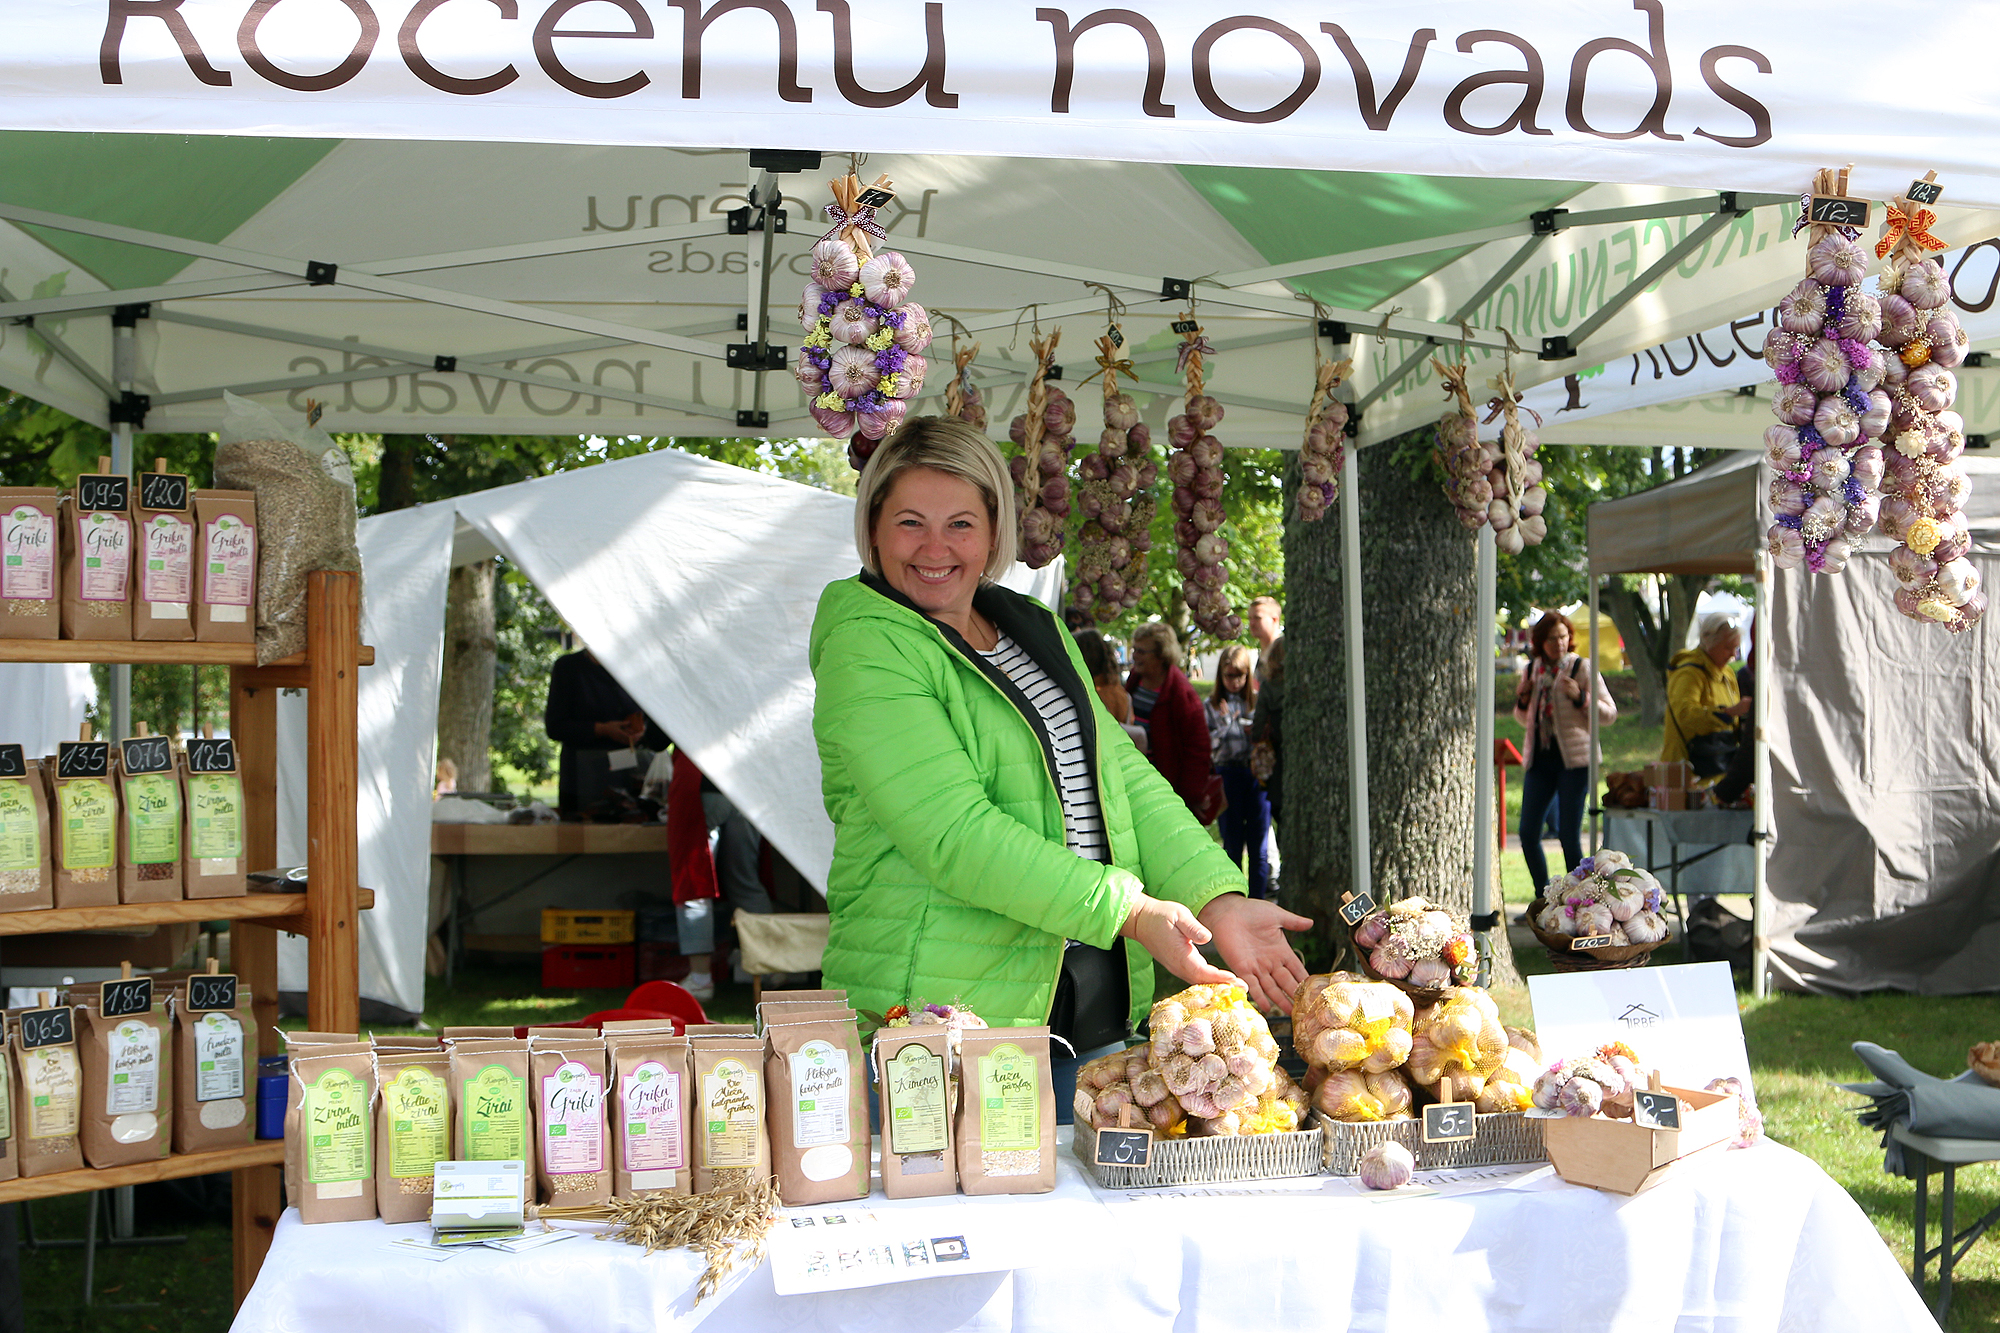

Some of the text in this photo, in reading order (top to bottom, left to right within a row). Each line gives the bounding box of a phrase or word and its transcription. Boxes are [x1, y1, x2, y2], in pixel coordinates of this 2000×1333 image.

[1035, 0, 1772, 149] novads
[81, 481, 124, 511] 0,95
[105, 981, 150, 1015] 1,85
[191, 978, 234, 1009] 0,85
[24, 1012, 66, 1046] 0,65
